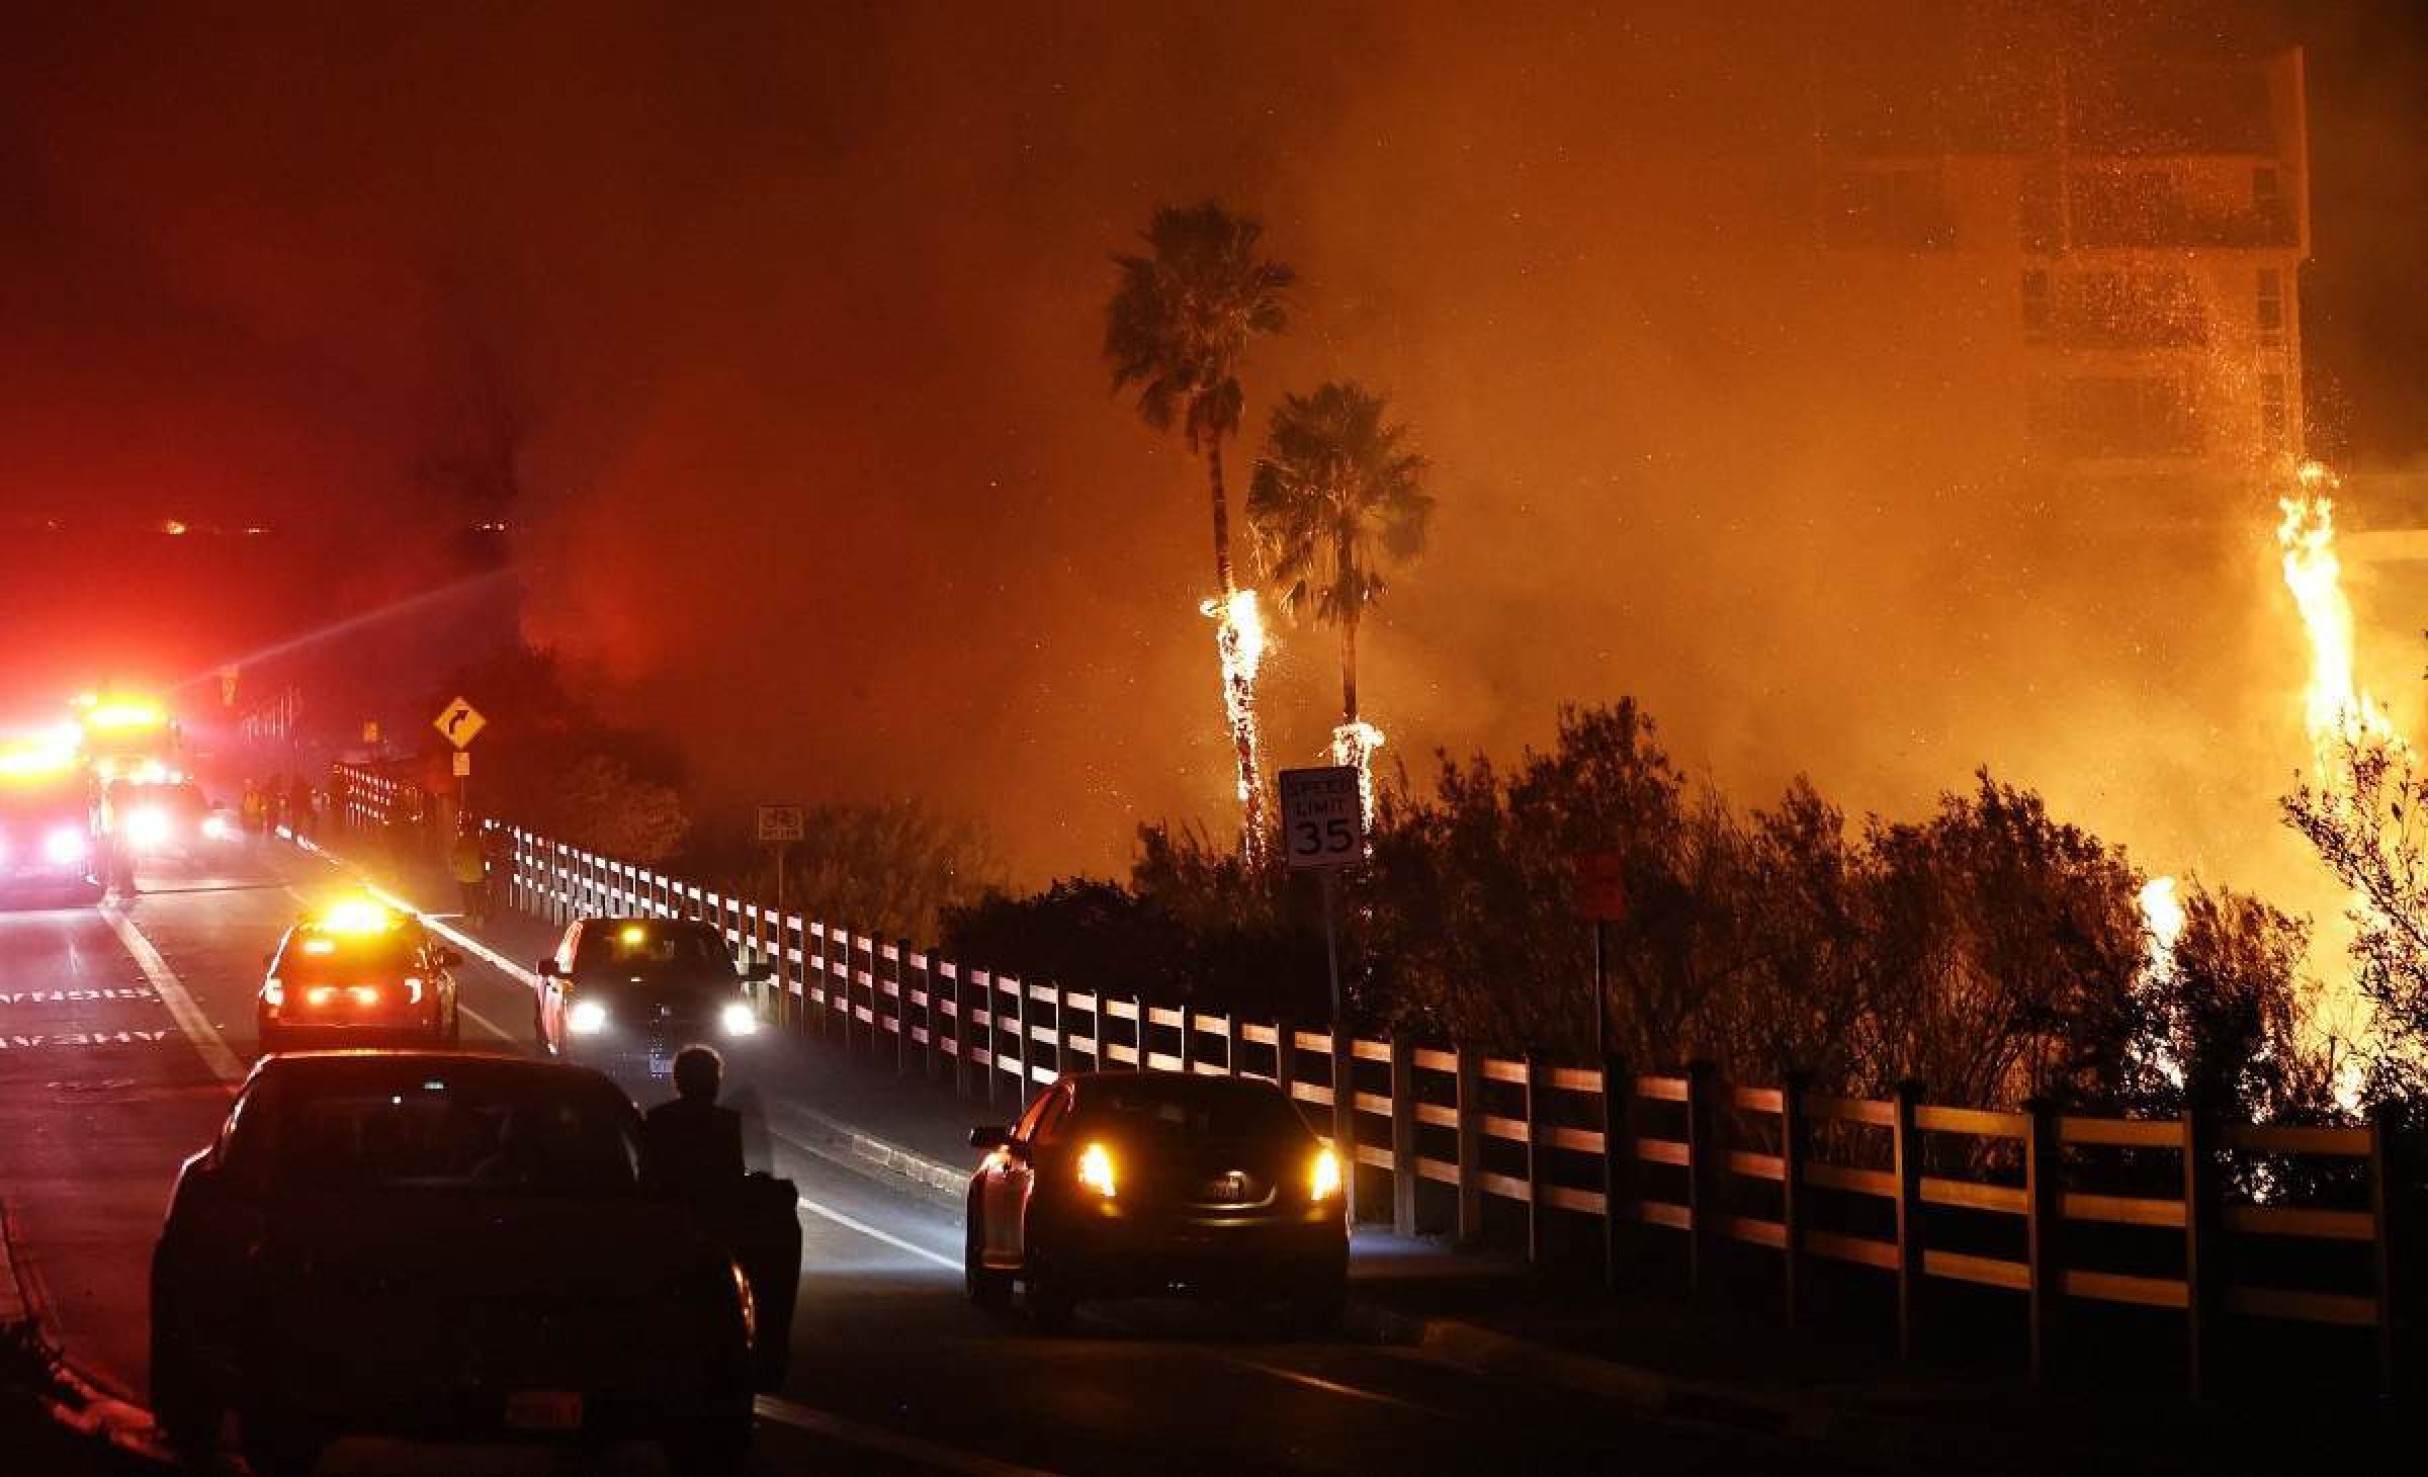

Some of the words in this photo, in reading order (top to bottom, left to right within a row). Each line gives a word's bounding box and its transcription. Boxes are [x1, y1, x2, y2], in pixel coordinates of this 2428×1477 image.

[1291, 780, 1354, 796] SPEED
[1295, 799, 1345, 816] LIMIT
[1294, 818, 1354, 855] 35
